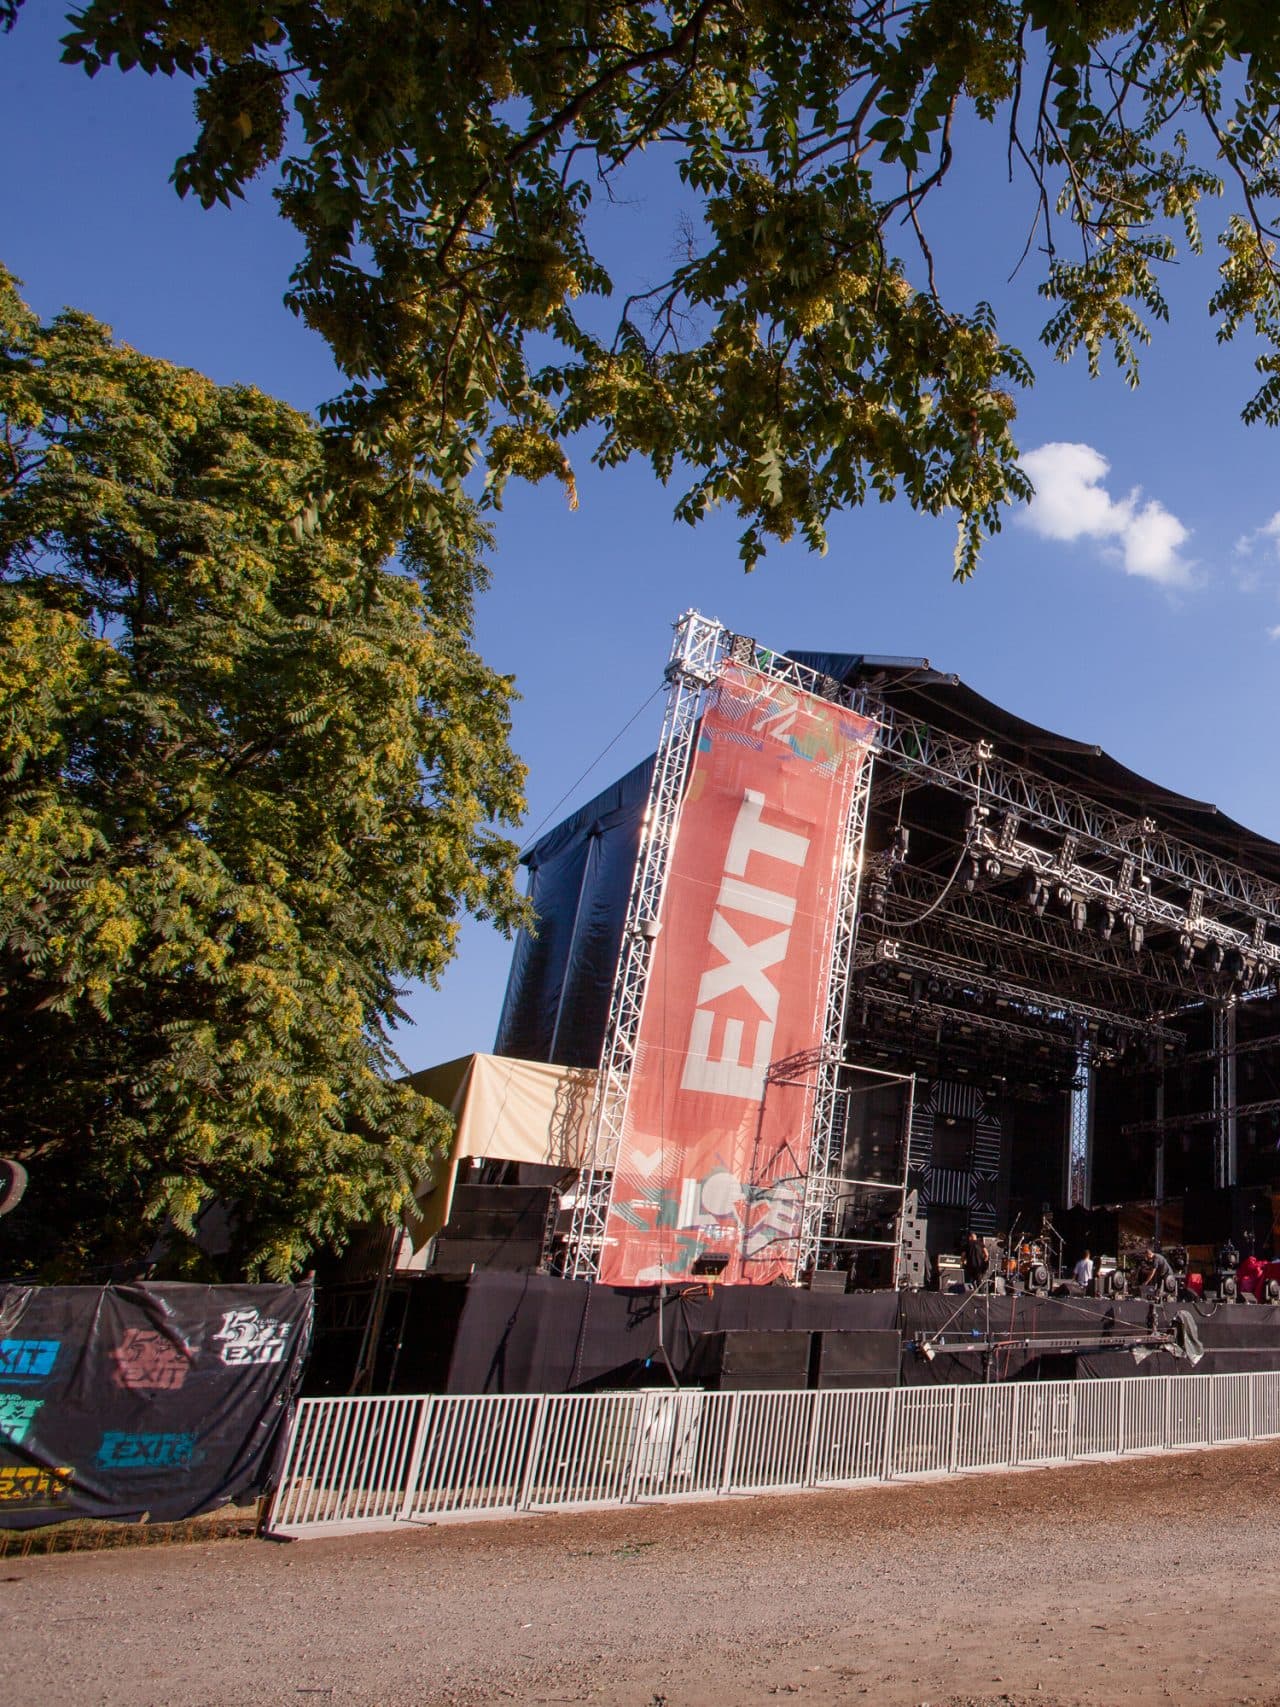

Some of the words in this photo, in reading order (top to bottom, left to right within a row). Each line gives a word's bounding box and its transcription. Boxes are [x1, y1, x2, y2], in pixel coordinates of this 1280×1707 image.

[680, 789, 811, 1100] EXIT
[211, 1310, 260, 1342] 15
[224, 1341, 285, 1363] EXIT
[120, 1366, 188, 1385] EXIT
[111, 1440, 176, 1460] EXIT
